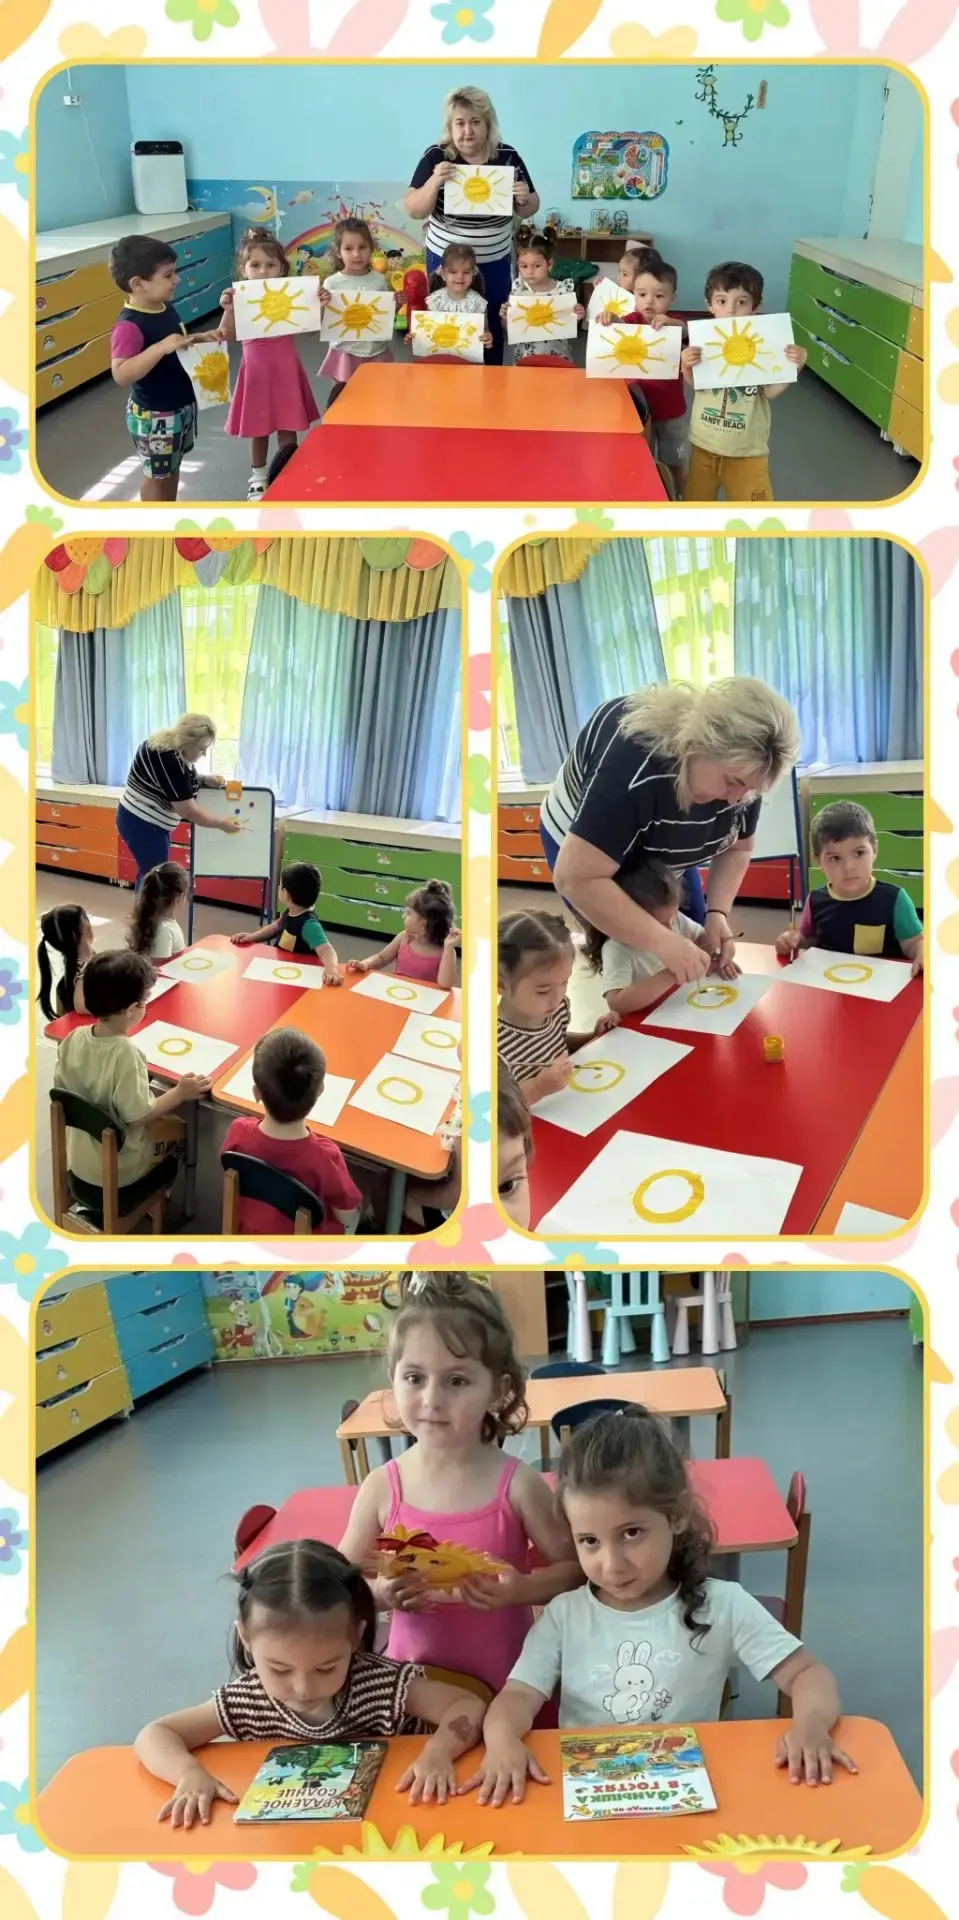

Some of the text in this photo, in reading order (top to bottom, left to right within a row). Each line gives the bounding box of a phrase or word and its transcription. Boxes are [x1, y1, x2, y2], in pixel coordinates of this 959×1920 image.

[701, 413, 721, 426] SANDY
[723, 420, 746, 430] BEACH
[278, 1788, 337, 1797] СОЛНЦЕ
[593, 1780, 680, 1793] В ГОСТЯХ
[576, 1791, 678, 1803] СОЛНЫШКА
[263, 1799, 342, 1809] КРАДЕНОЕ
